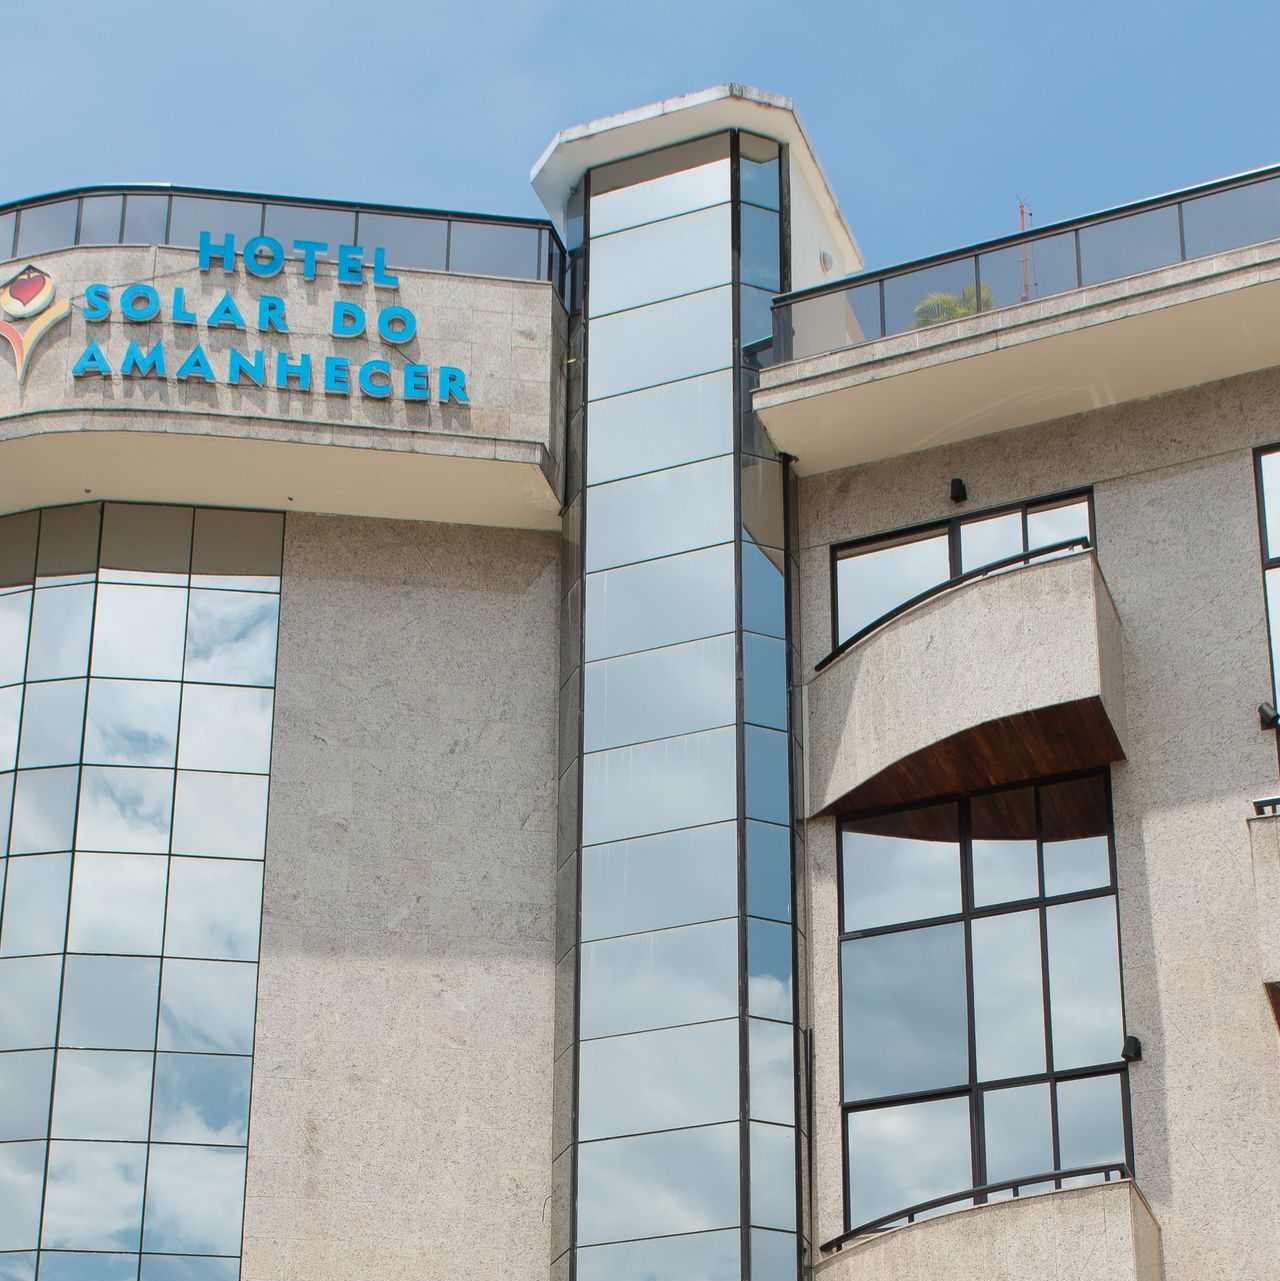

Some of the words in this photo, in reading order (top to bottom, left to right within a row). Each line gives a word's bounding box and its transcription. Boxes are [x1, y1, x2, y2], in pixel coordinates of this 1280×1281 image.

[199, 230, 399, 288] HOTEL
[83, 283, 289, 333] SOLAR
[331, 301, 418, 345] DO
[72, 338, 470, 403] AMANHECER
